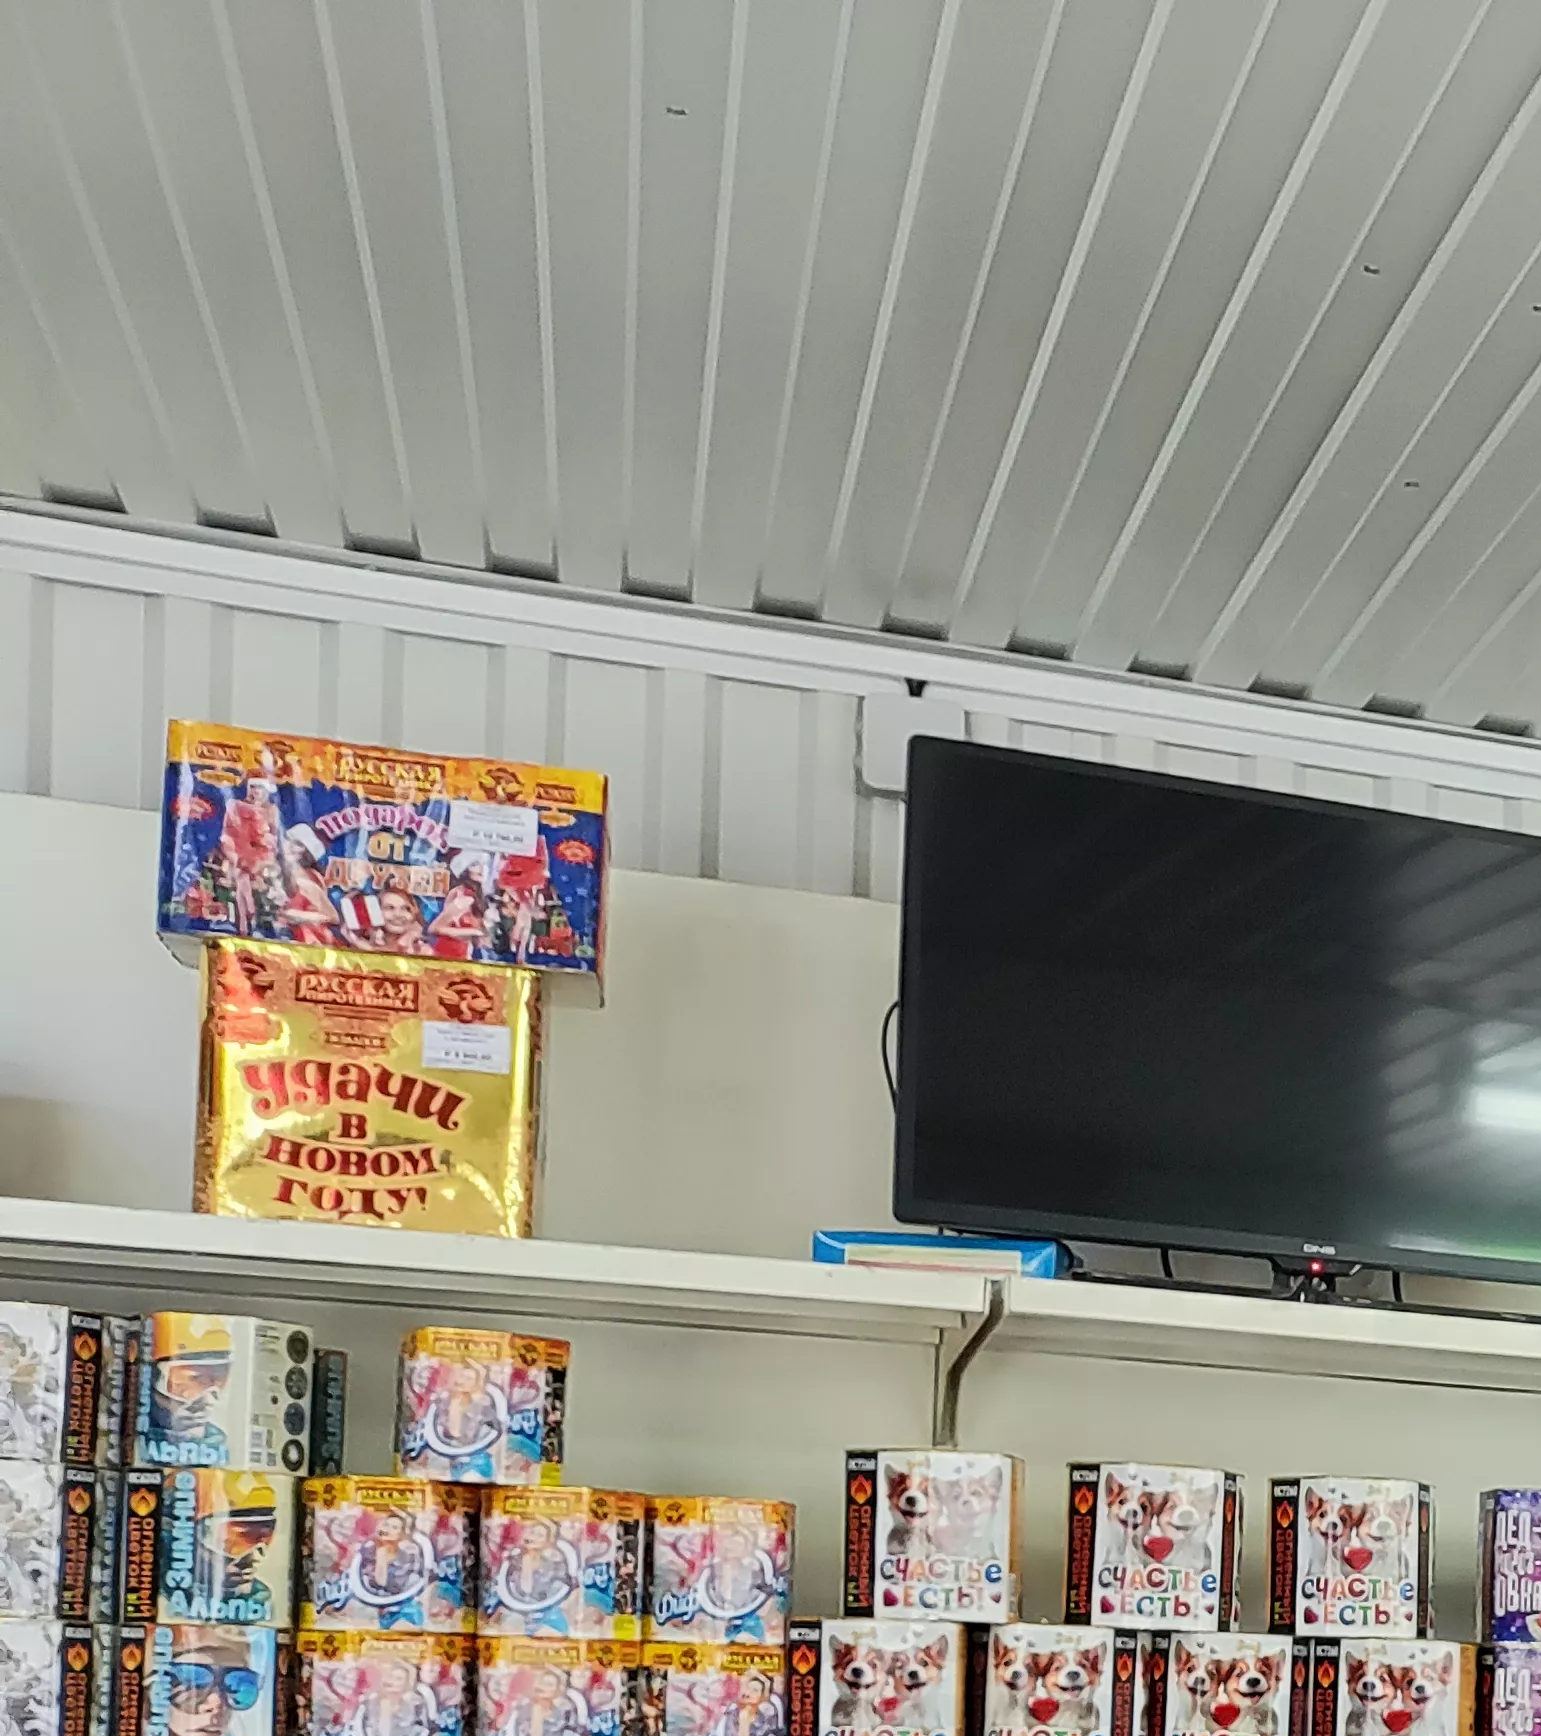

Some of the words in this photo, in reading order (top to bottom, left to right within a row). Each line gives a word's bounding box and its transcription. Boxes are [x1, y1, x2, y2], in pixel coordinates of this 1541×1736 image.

[369, 832, 409, 861] ОТ
[326, 857, 449, 898] ДРУЗЕЙ
[299, 972, 417, 1000] РУССКАЯ
[337, 1112, 368, 1140] В
[264, 1135, 439, 1177] НОВОМ
[273, 1175, 428, 1221] ГОДУ!
[165, 1470, 196, 1590] ЗИМНИЕ
[167, 1591, 272, 1623] АЛЬПЫ
